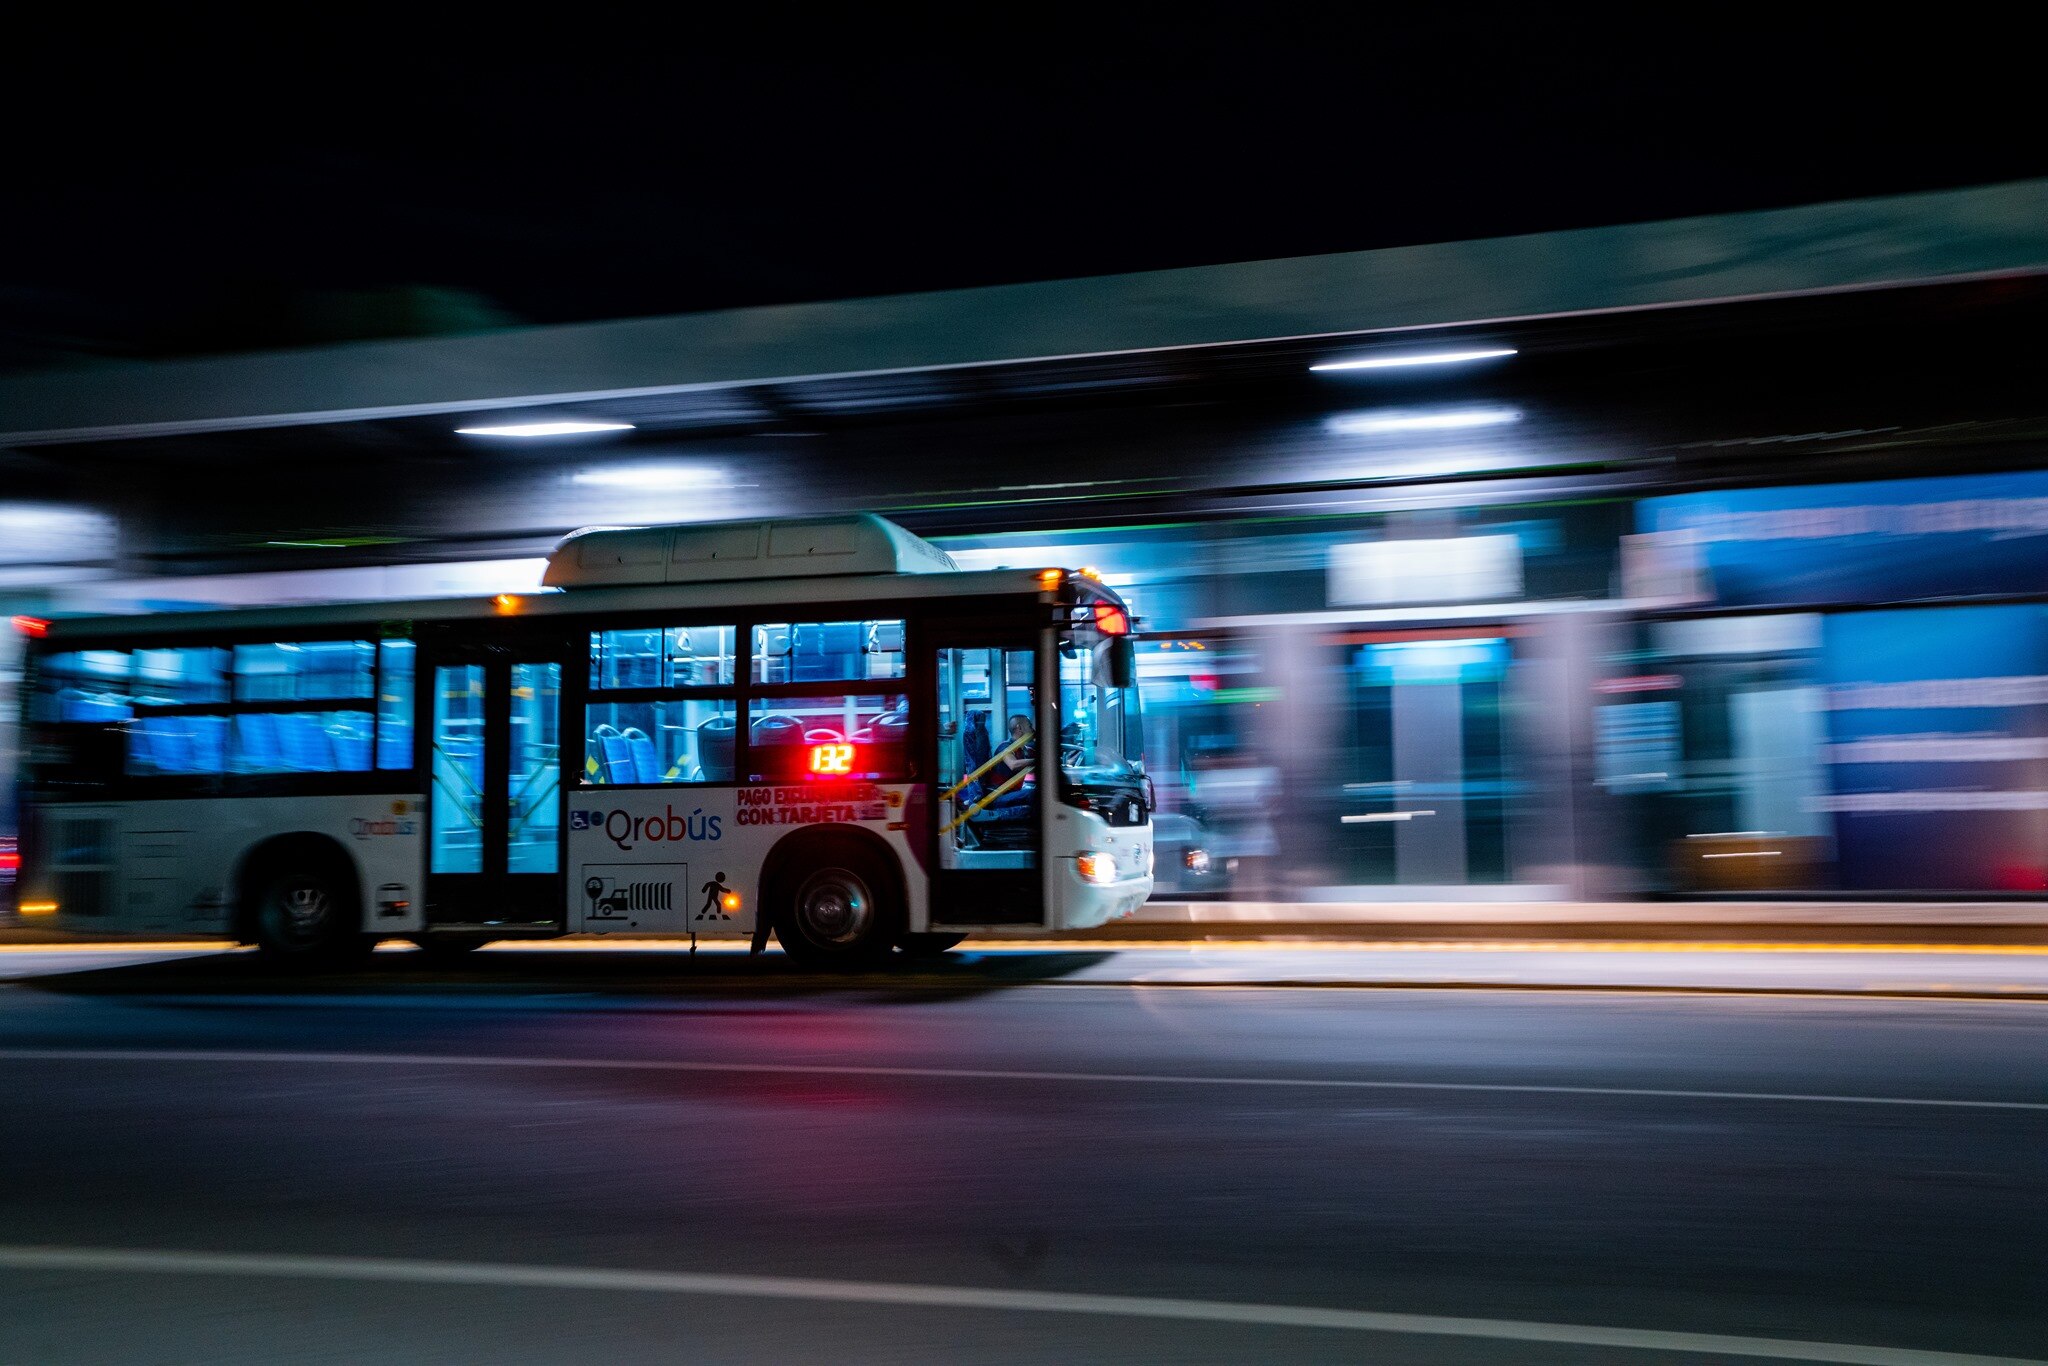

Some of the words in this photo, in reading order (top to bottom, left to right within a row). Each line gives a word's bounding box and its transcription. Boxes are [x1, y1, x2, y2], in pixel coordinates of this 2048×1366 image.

[811, 743, 854, 772] 132
[737, 788, 771, 805] PAGO
[606, 804, 722, 850] Qrobús
[736, 807, 773, 826] CON
[780, 805, 858, 823] TARJETA
